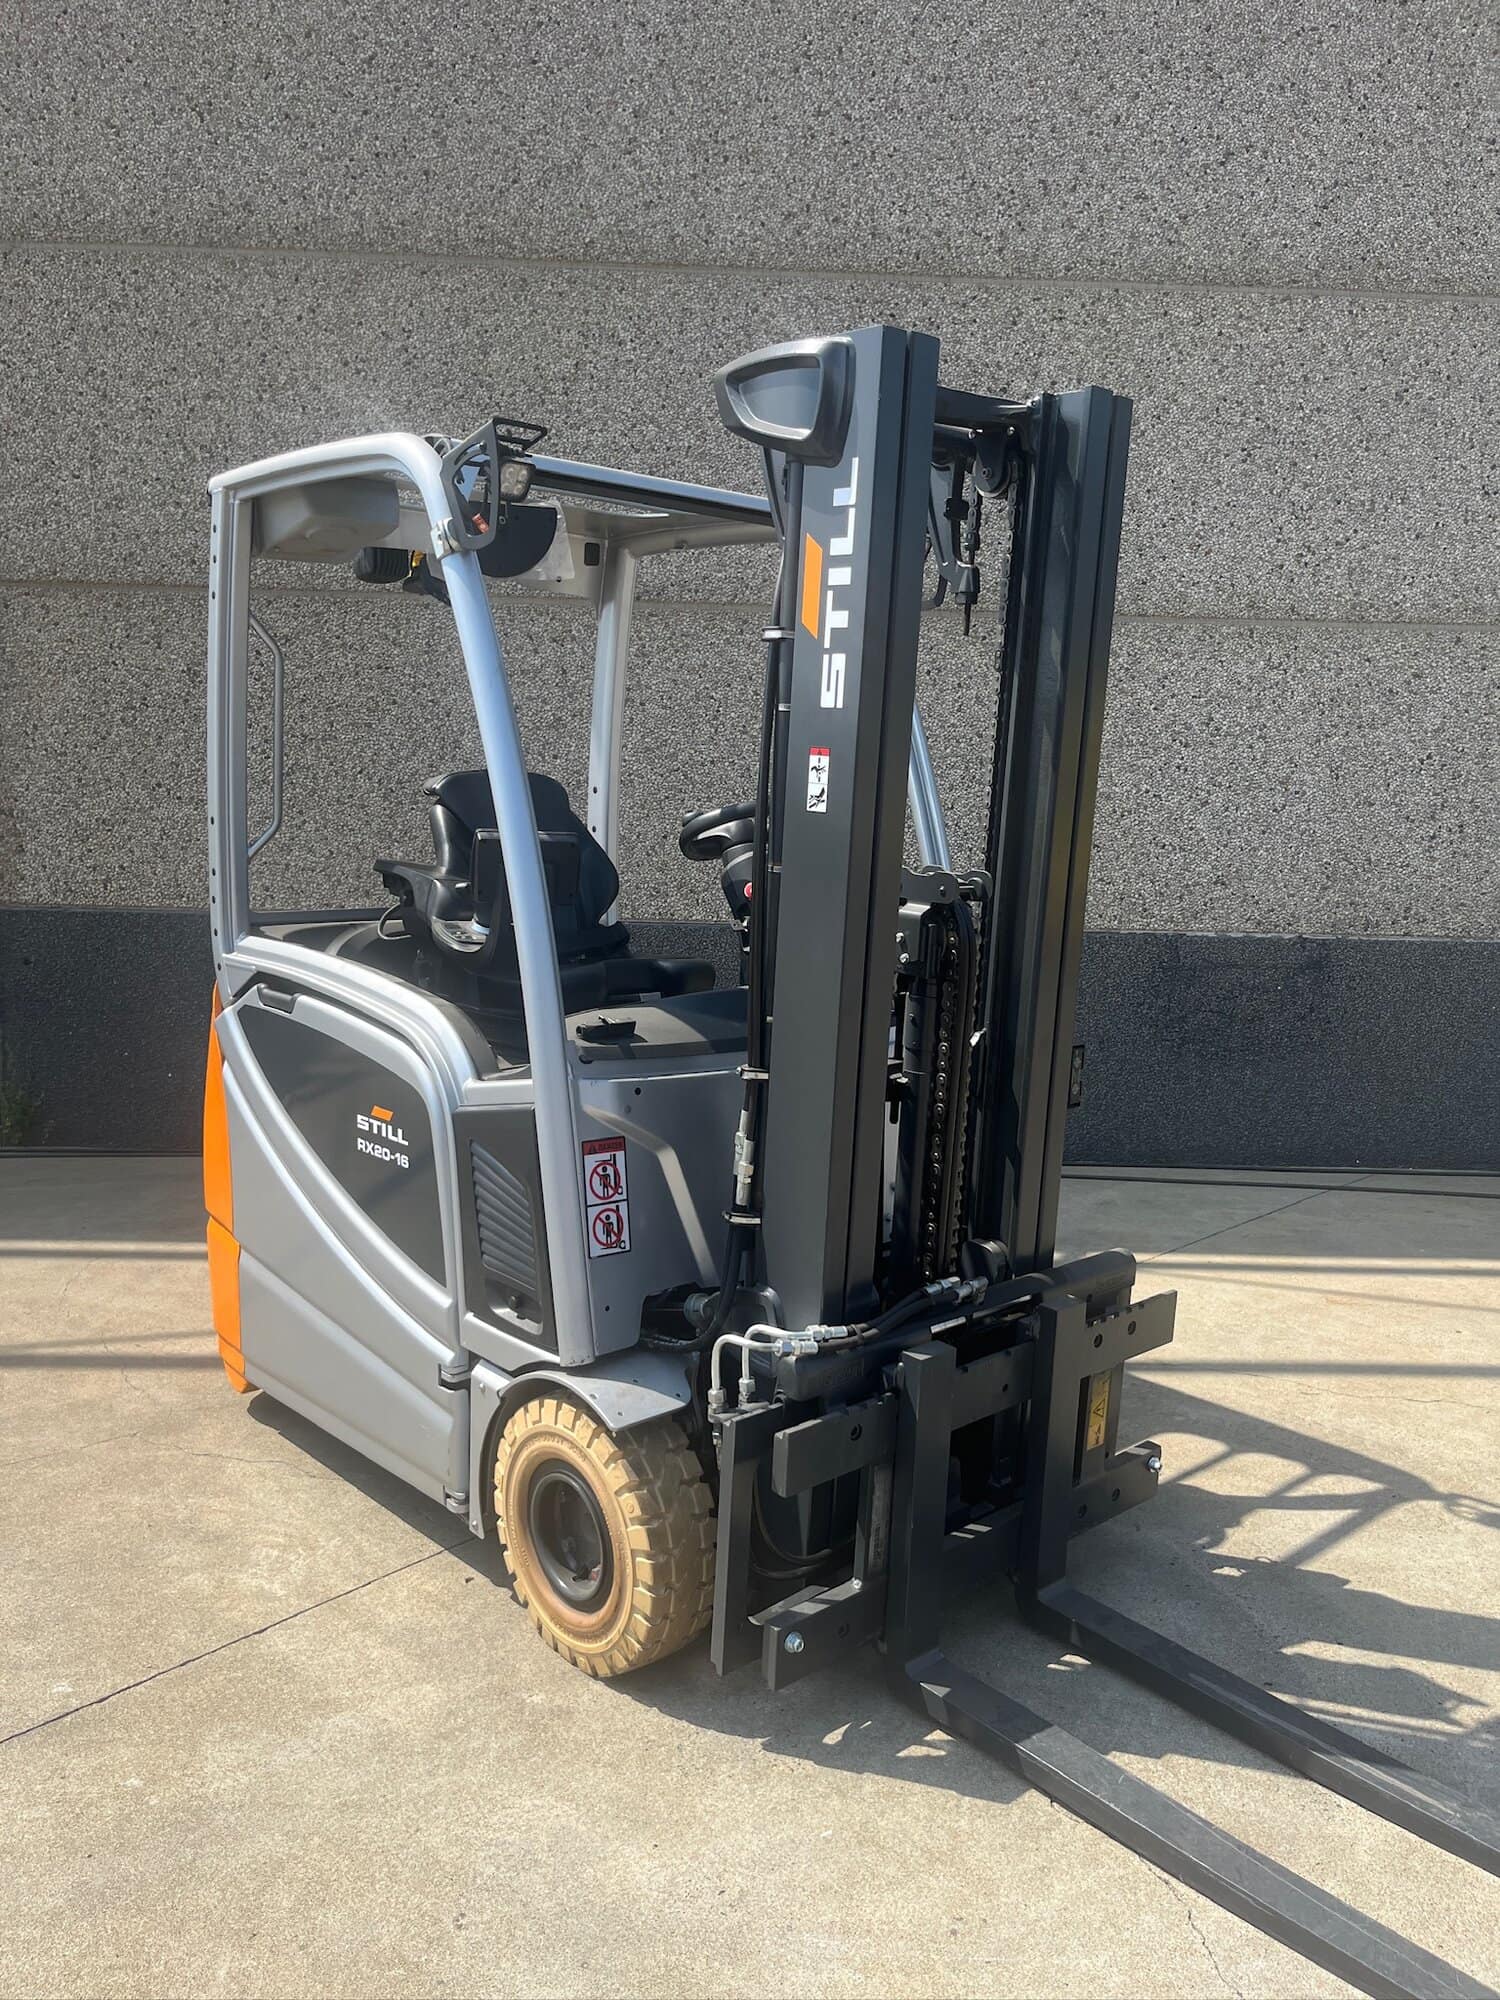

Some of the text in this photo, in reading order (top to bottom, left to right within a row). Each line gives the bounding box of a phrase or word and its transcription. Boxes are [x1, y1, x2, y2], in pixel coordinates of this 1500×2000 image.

[820, 457, 859, 709] STILL
[356, 1114, 409, 1146] STILL
[357, 1137, 409, 1169] RX20-16
